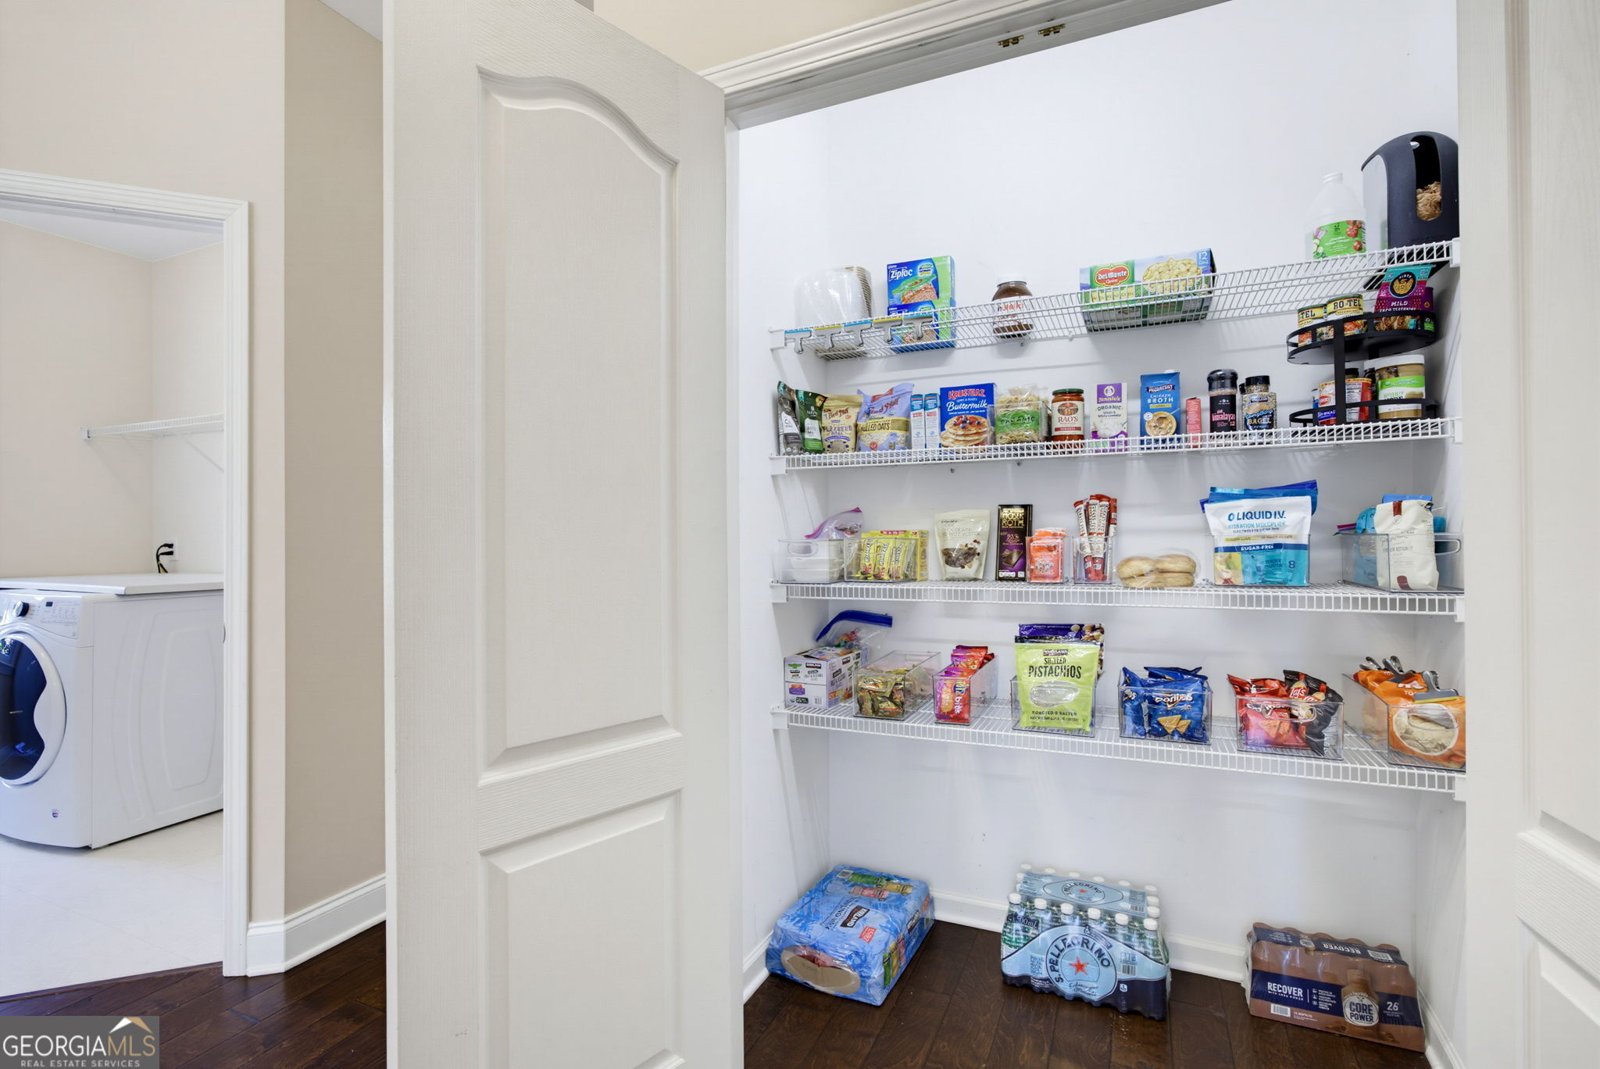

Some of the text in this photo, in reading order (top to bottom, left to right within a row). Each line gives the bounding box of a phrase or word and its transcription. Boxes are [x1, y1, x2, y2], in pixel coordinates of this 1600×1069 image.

[890, 268, 913, 279] Ziploc
[1108, 270, 1127, 279] Monte
[946, 400, 988, 412] Buttermilk
[1248, 416, 1271, 424] BAGEL
[1236, 511, 1272, 521] LIQUID
[1001, 519, 1024, 527] ROTH
[1288, 560, 1296, 569] 8
[1028, 665, 1082, 679] PISTACHIOS
[1155, 693, 1193, 703] Doritos
[1323, 943, 1361, 954] RECOVER
[1267, 981, 1303, 997] RECOVER
[1350, 1001, 1374, 1014] CORE
[1386, 1001, 1399, 1011] 26
[1350, 1013, 1374, 1023] POWER
